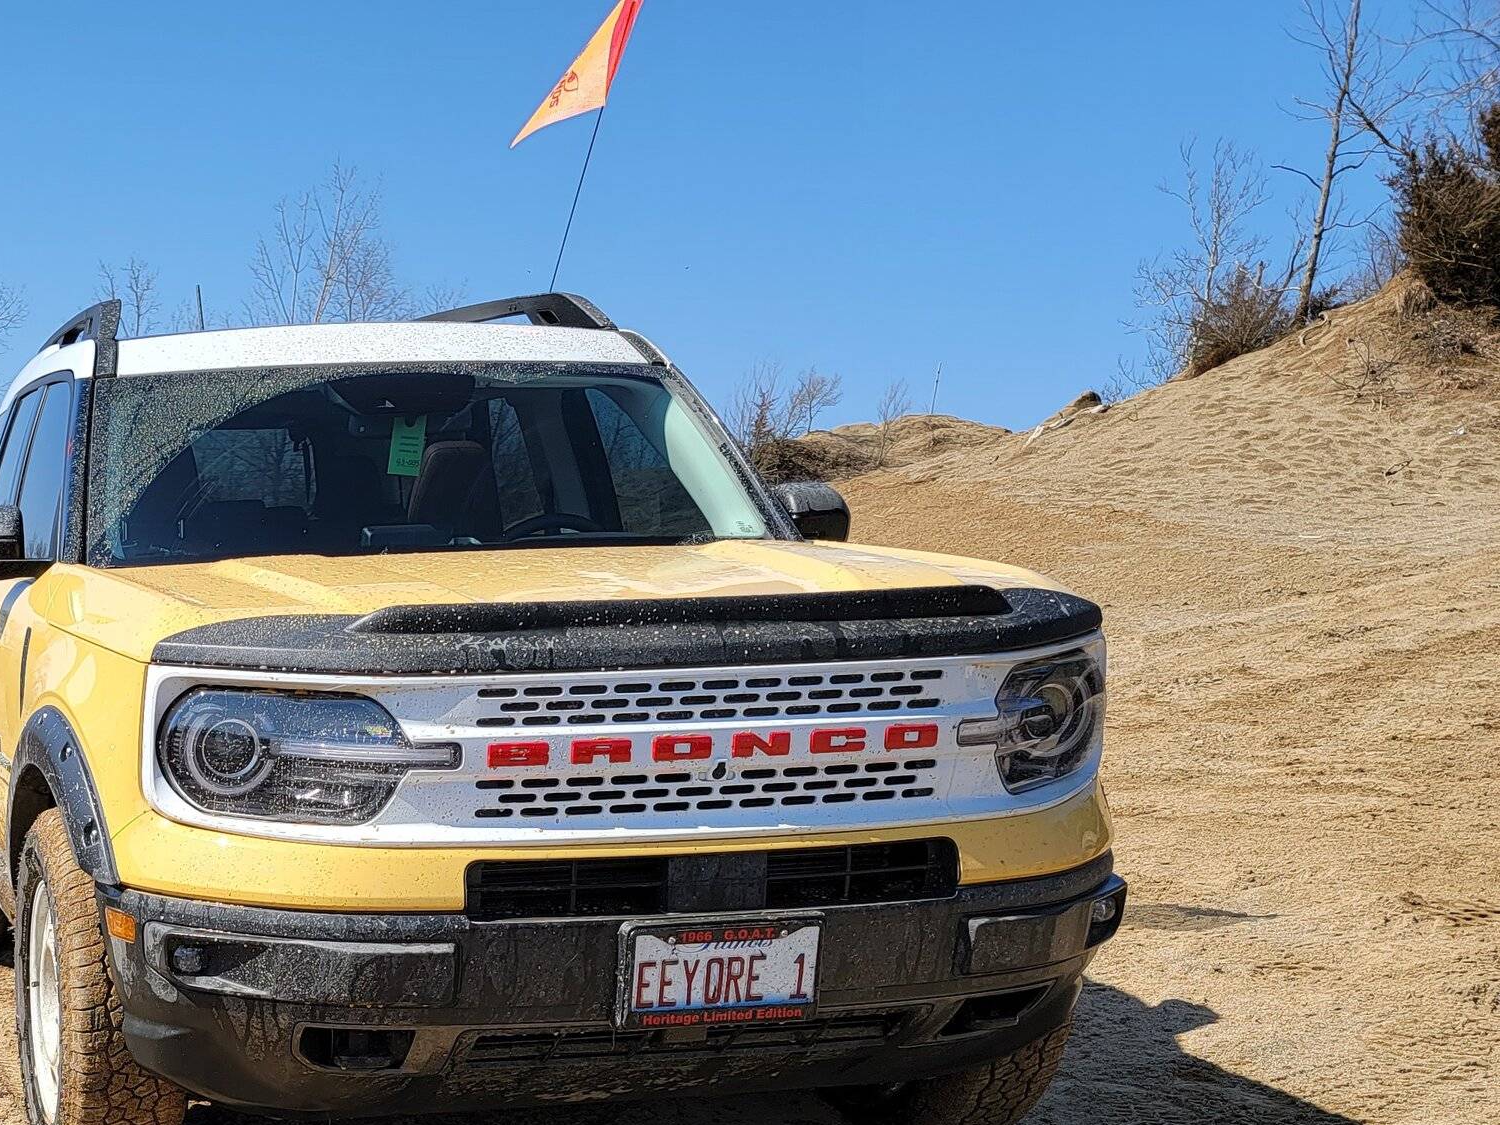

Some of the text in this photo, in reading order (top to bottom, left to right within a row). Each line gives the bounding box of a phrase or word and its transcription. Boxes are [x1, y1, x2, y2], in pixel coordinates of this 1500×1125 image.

[486, 723, 939, 768] BRONCO
[681, 931, 714, 943] 1966
[635, 953, 807, 1009] EEYORE 1
[643, 1008, 803, 1026] Heritage Limited Edition
